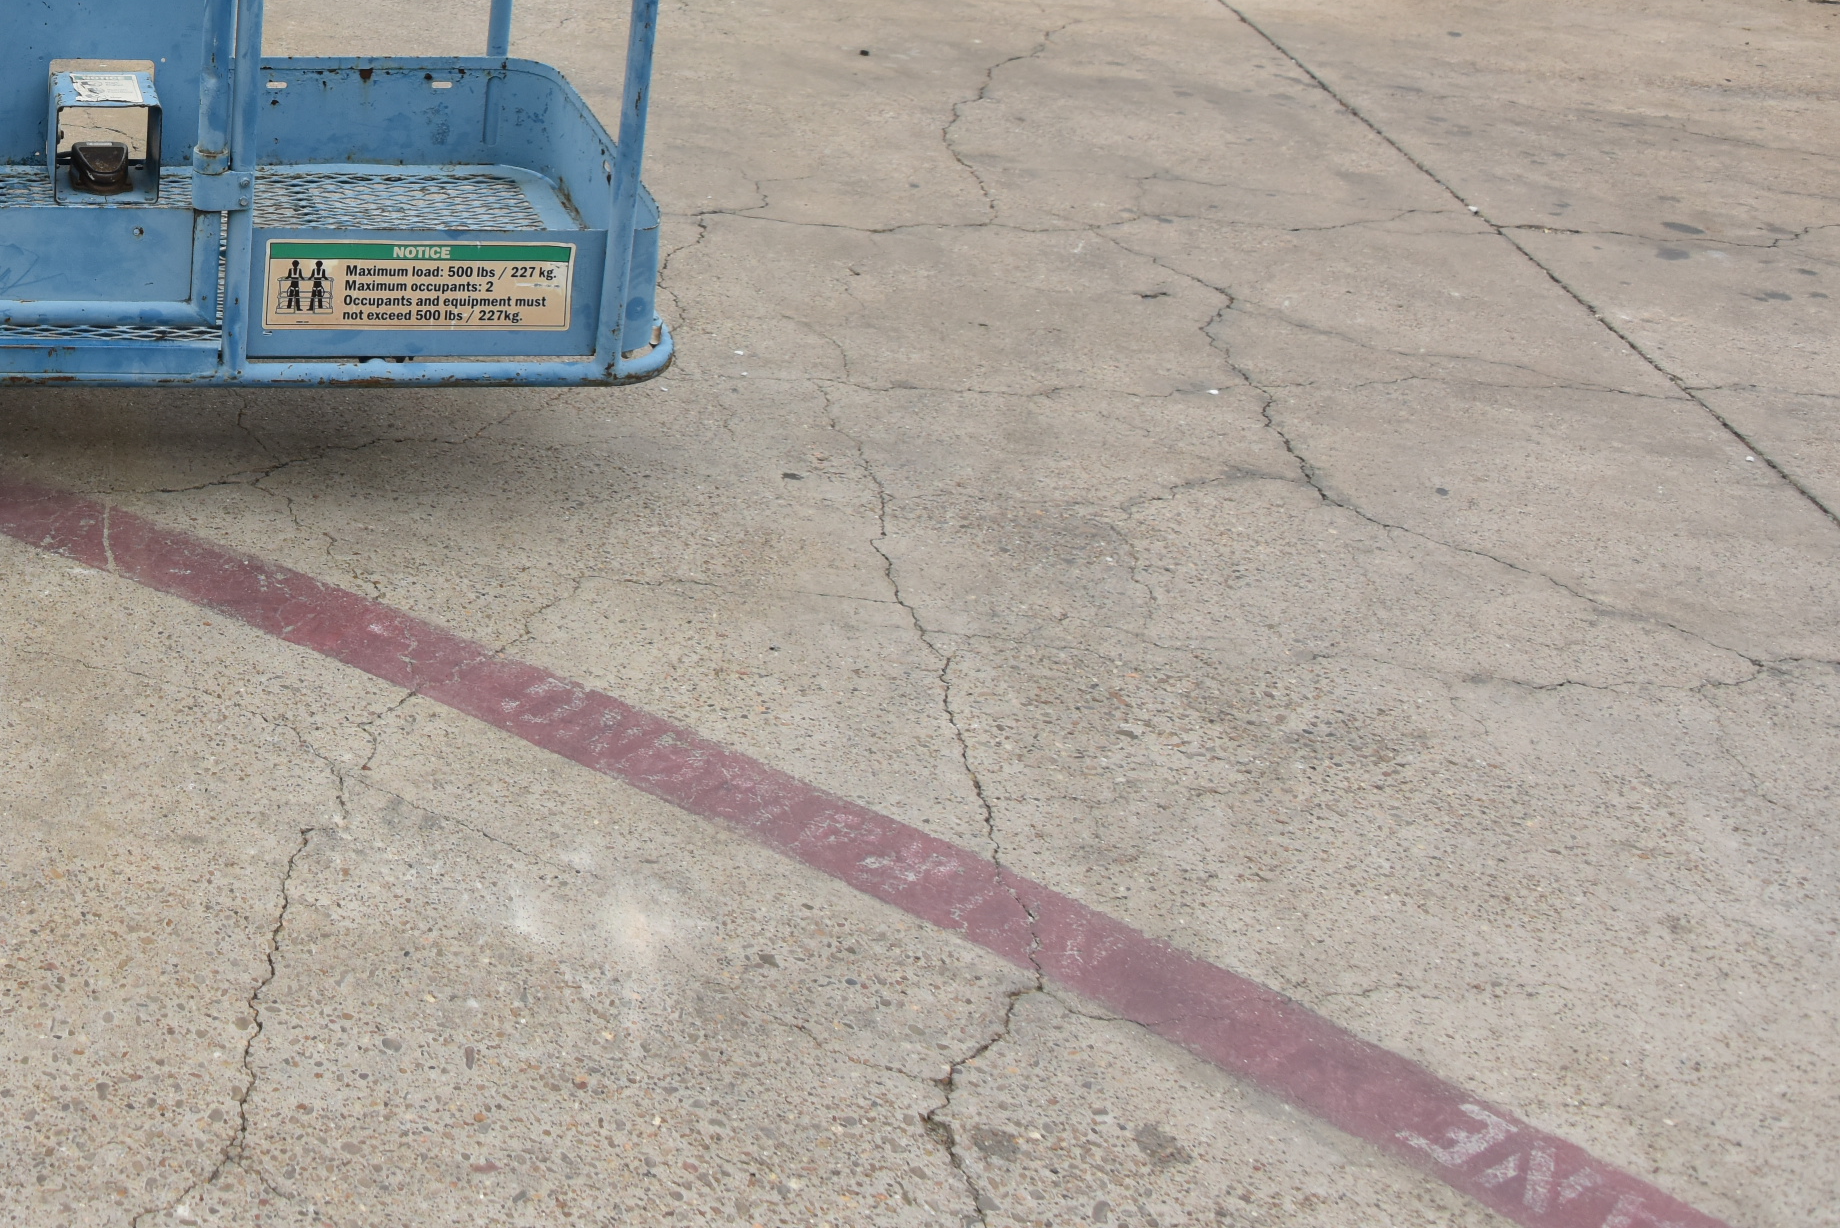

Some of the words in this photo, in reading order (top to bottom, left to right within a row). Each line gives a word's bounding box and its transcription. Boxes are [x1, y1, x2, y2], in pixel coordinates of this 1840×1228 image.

[393, 246, 451, 259] NOTICE
[345, 265, 409, 278] Maximum
[412, 265, 444, 278] load:
[447, 266, 473, 278] 500
[476, 266, 496, 278] lbs
[497, 266, 508, 280] /
[510, 267, 536, 278] 227
[538, 267, 557, 280] kg.
[344, 280, 408, 292] Maximum
[411, 281, 483, 295] occupants:
[485, 281, 494, 292] 2
[343, 295, 412, 309] Occupants
[415, 295, 440, 307] and
[443, 296, 512, 311] equipment
[515, 297, 547, 307] must
[342, 311, 364, 321] not
[366, 309, 412, 321] exceed
[415, 310, 441, 321] 500
[444, 309, 464, 321] lbs
[465, 310, 476, 323] /
[478, 310, 523, 324] 227kg.
